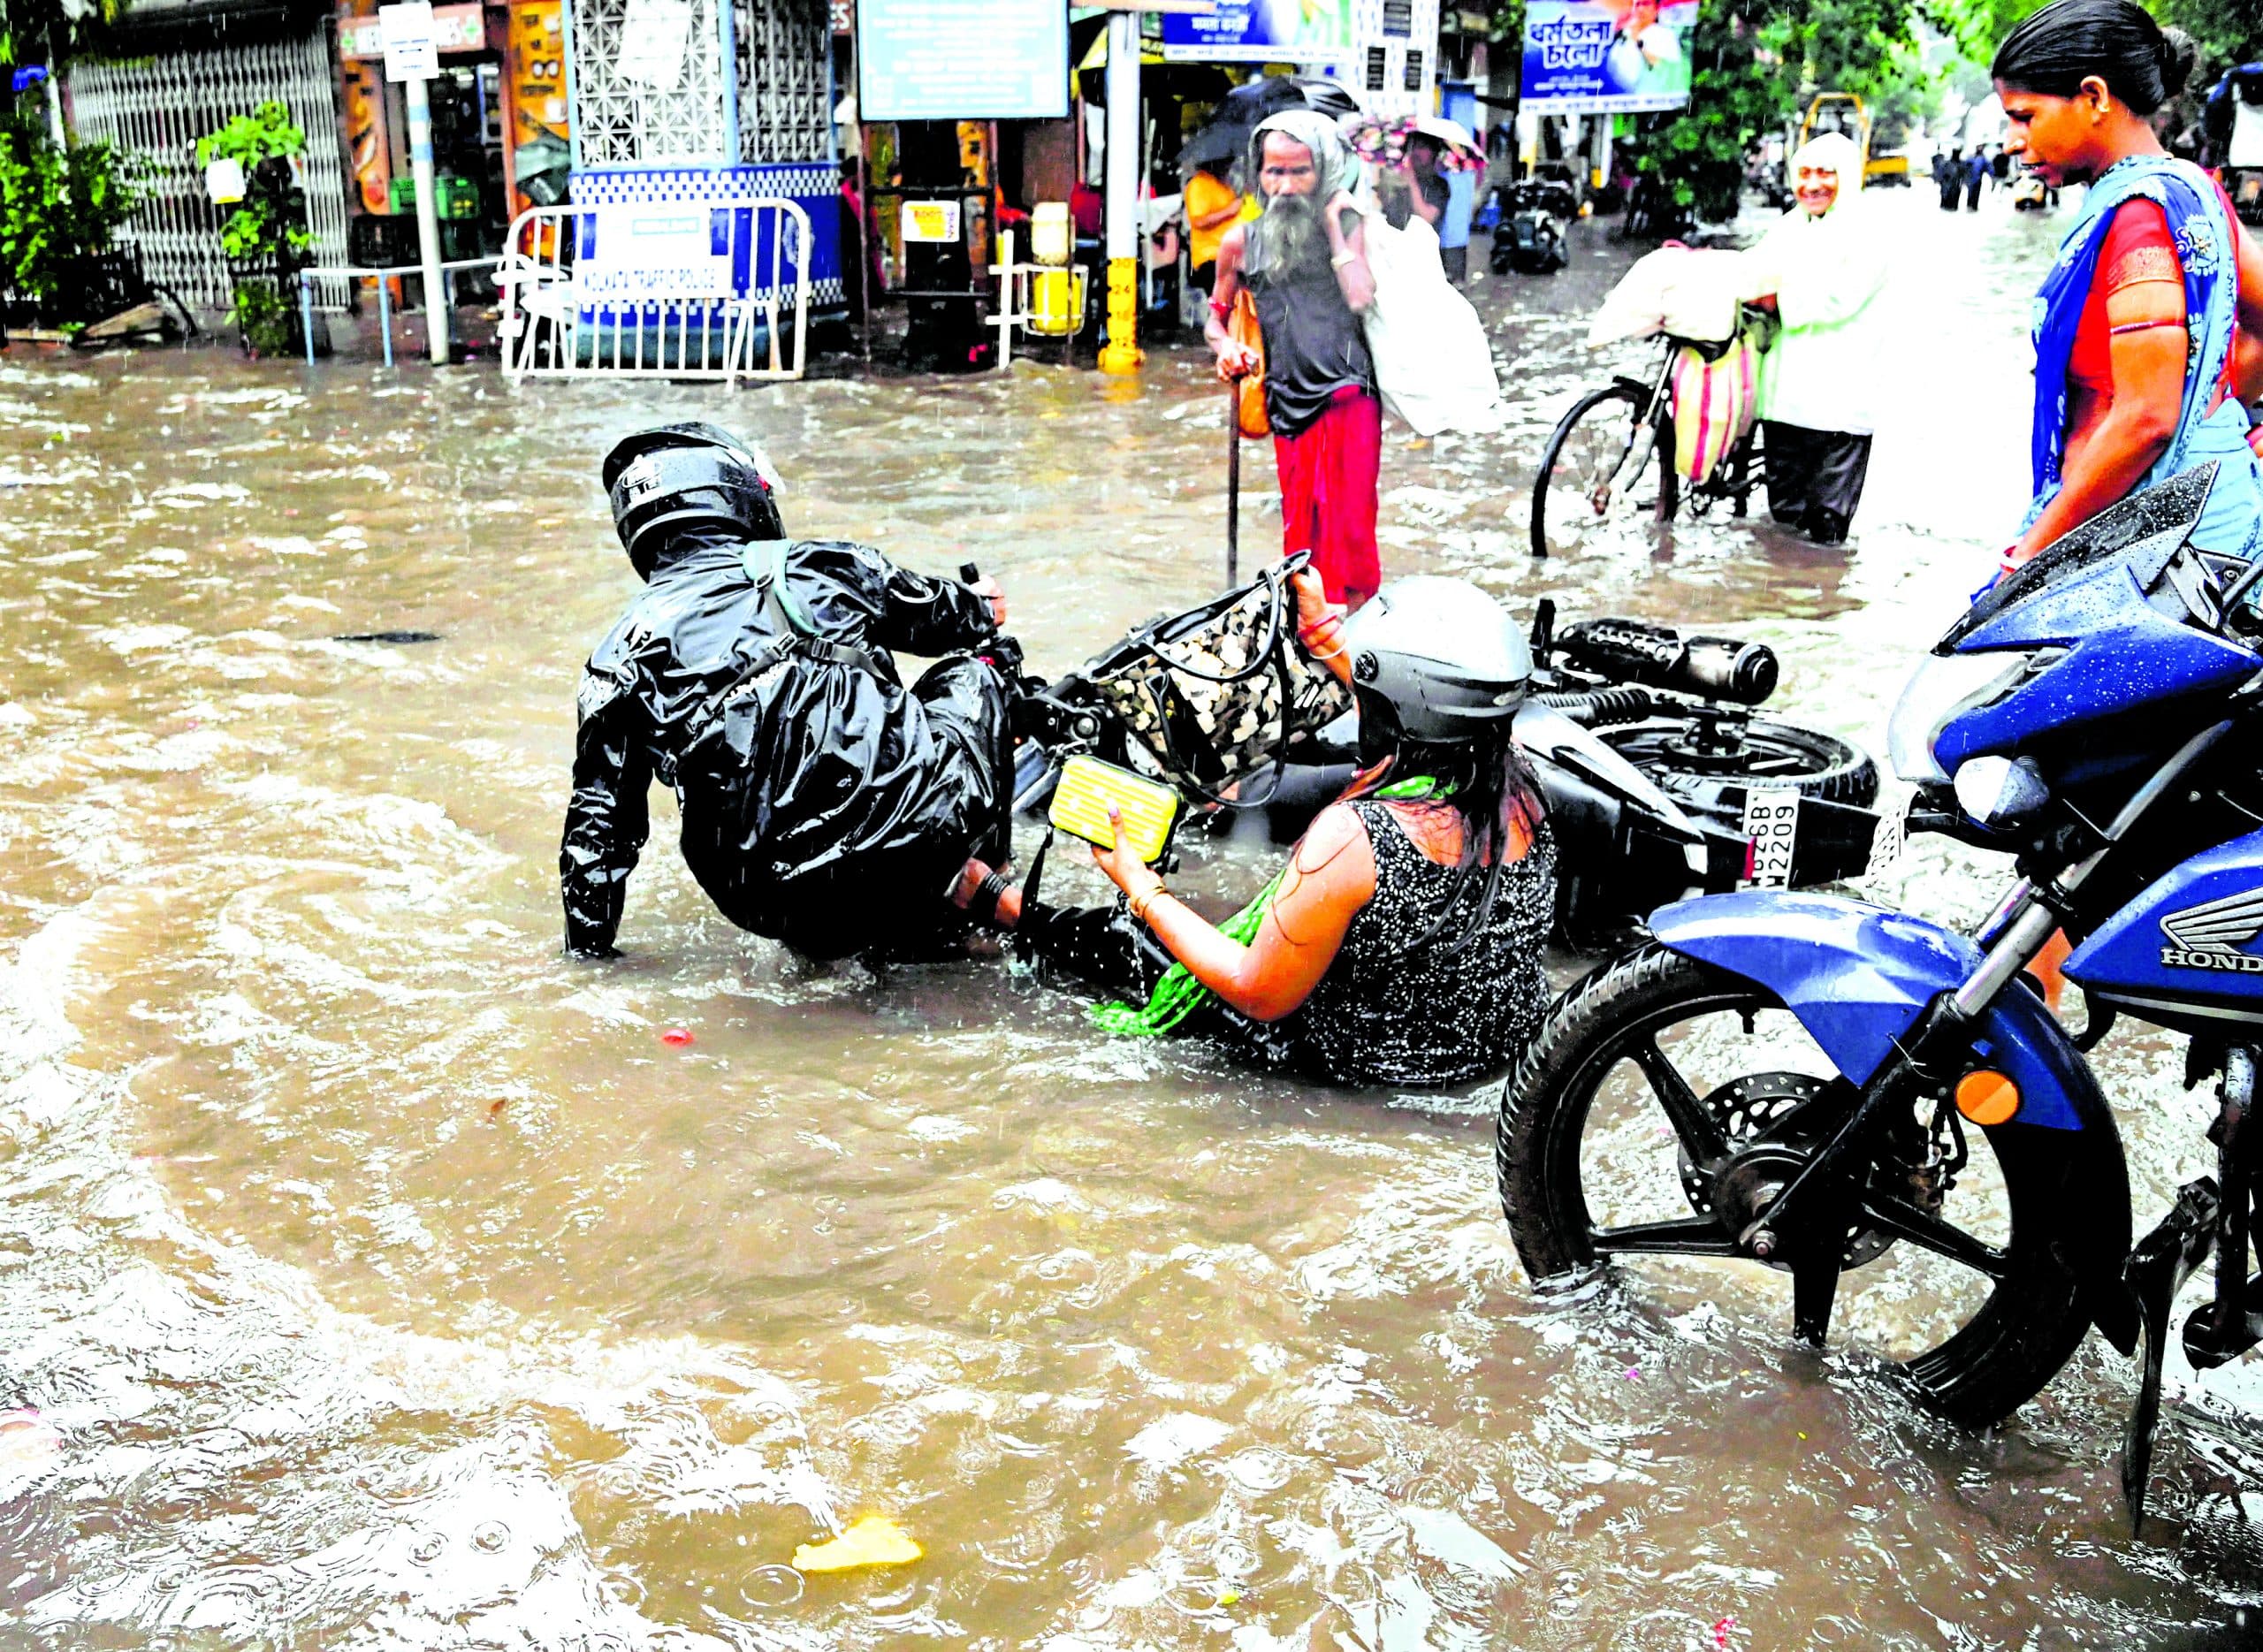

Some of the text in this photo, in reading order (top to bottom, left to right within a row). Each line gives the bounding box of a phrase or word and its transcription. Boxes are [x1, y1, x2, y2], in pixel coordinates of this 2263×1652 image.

[1529, 14, 1612, 43] ধর্মতলা
[1547, 44, 1598, 65] চলো
[1114, 284, 1131, 295] 24
[1115, 337, 1130, 348] 12
